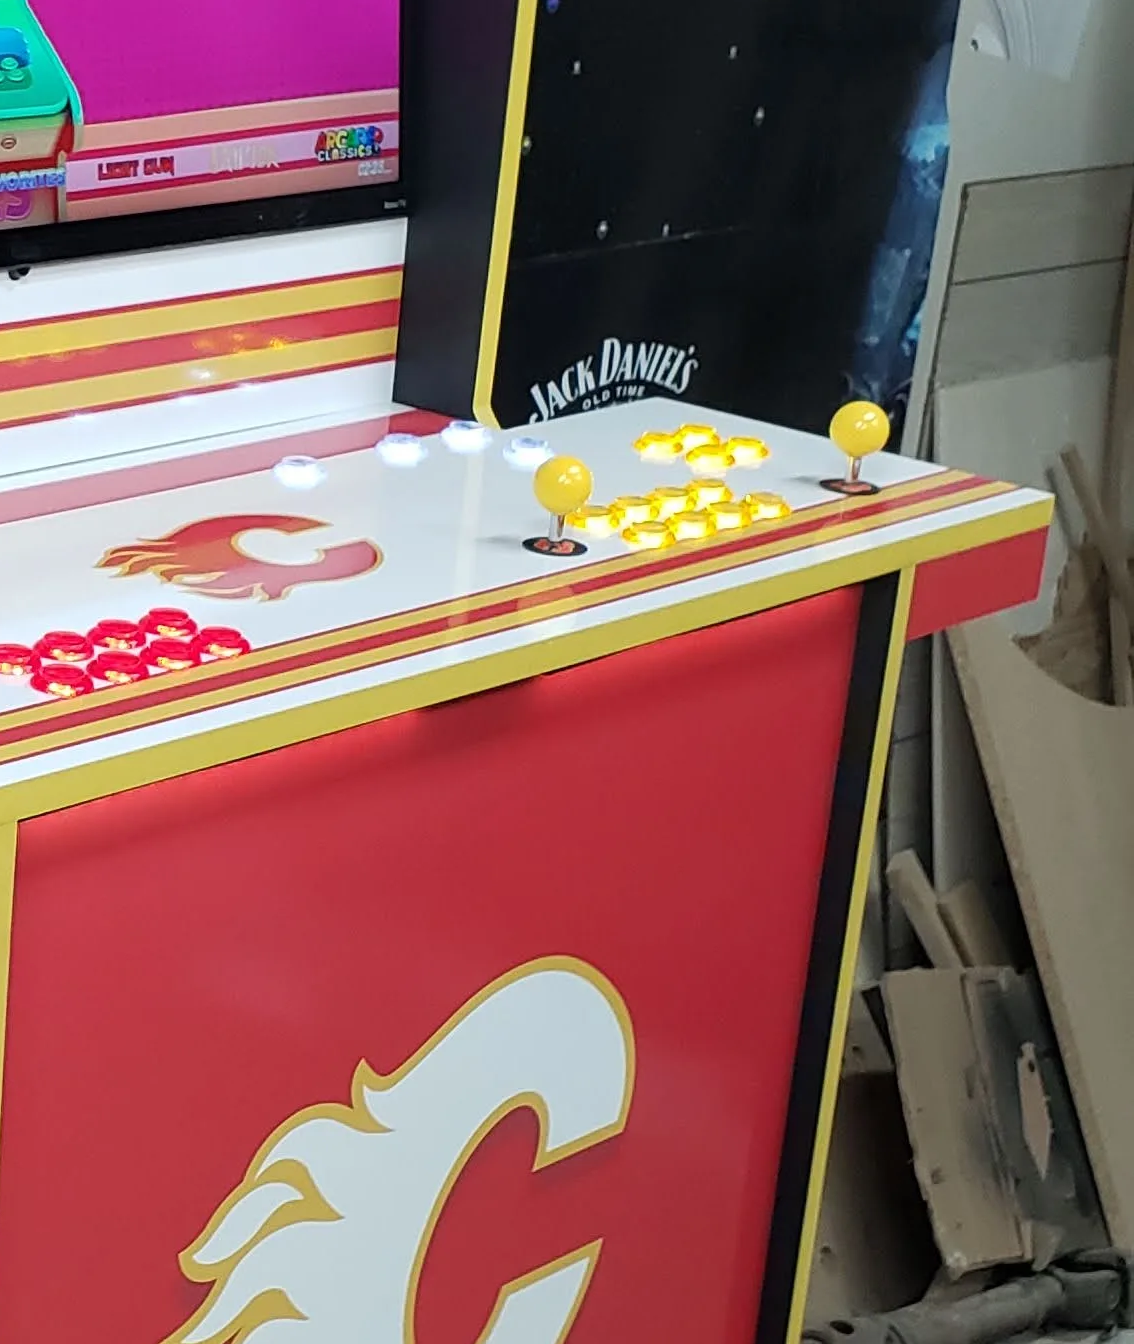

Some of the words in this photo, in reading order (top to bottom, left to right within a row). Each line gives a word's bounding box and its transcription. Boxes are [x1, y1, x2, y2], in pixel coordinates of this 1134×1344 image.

[317, 144, 373, 162] CLASSICS
[529, 356, 596, 425] JACK
[598, 337, 699, 394] DANIEL'S
[582, 389, 611, 411] OLD
[616, 385, 646, 398] TIME
